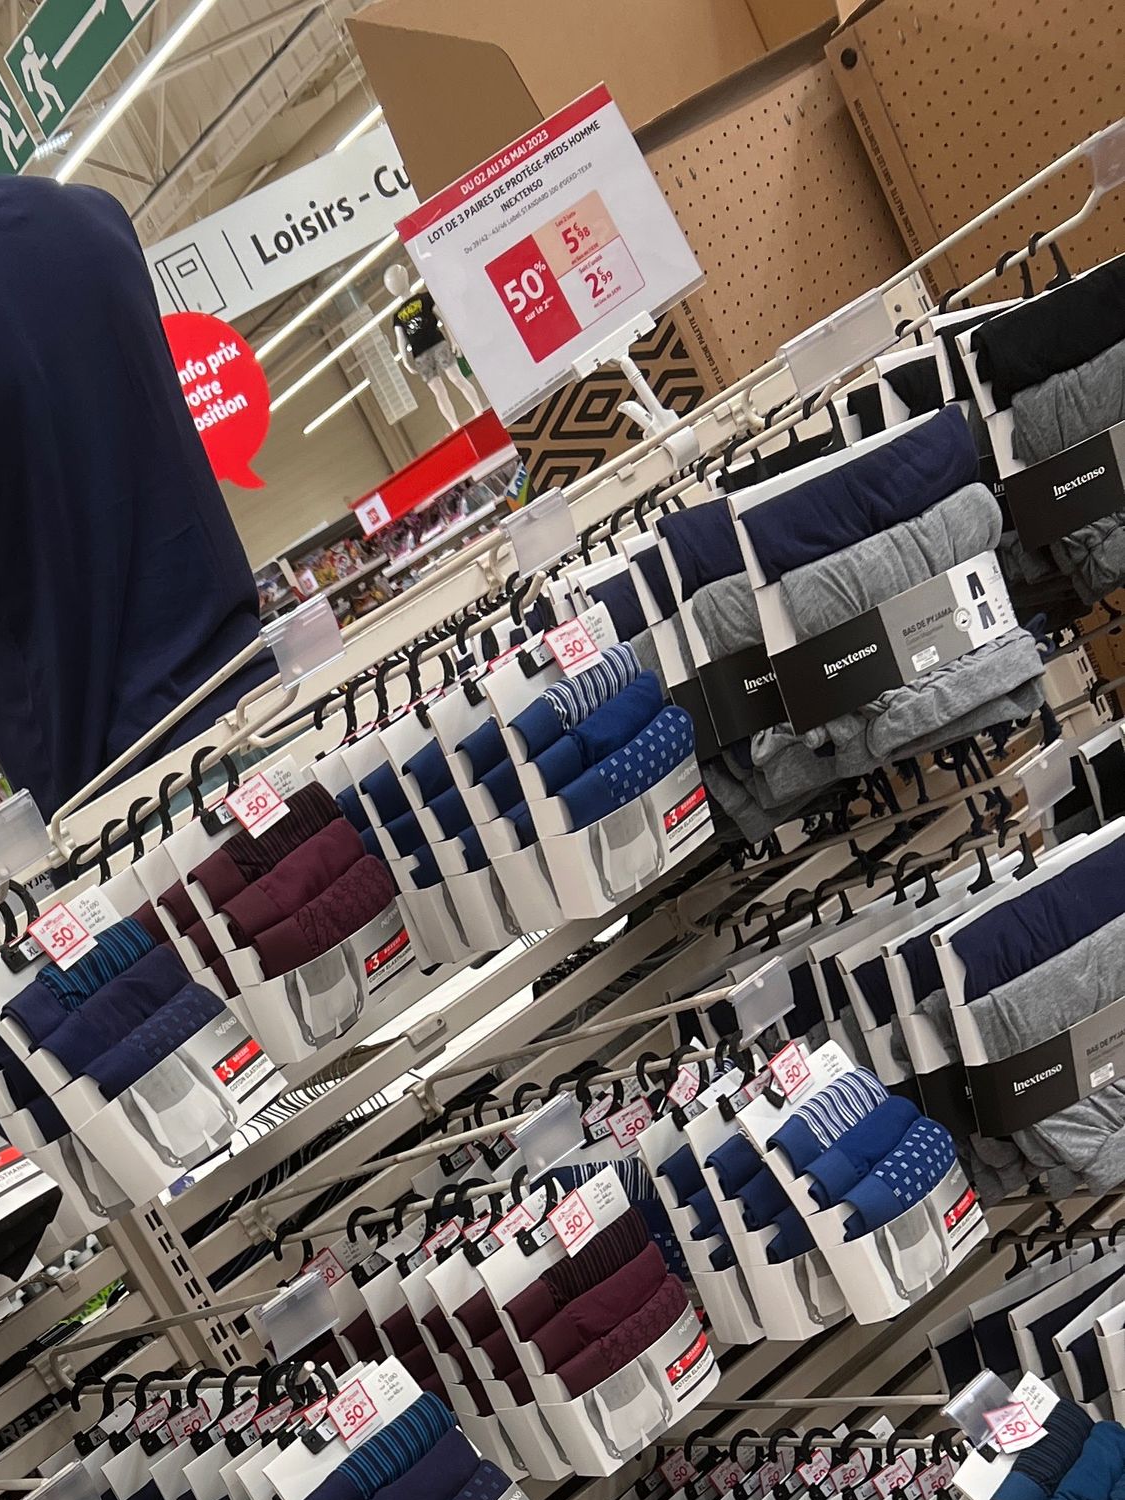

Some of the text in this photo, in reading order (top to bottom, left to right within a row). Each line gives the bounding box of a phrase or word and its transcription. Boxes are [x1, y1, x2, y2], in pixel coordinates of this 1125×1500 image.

[459, 128, 549, 195] DU 02 AU 16 MAI 2023
[426, 225, 446, 244] LOT
[443, 217, 458, 232] DE
[455, 212, 465, 224] 3
[462, 192, 494, 219] PAIRES
[491, 183, 506, 199] DE
[566, 118, 601, 147] HOMME
[499, 176, 544, 213] INEXTENSO
[247, 185, 357, 265] Loisirs
[523, 301, 544, 323] sur le
[172, 336, 244, 386] nfo prix
[182, 375, 224, 410] otre
[189, 386, 248, 433] osition
[1050, 463, 1107, 498] Inextenso
[823, 641, 879, 678] Inextenso
[1010, 1061, 1064, 1094] Inextenso
